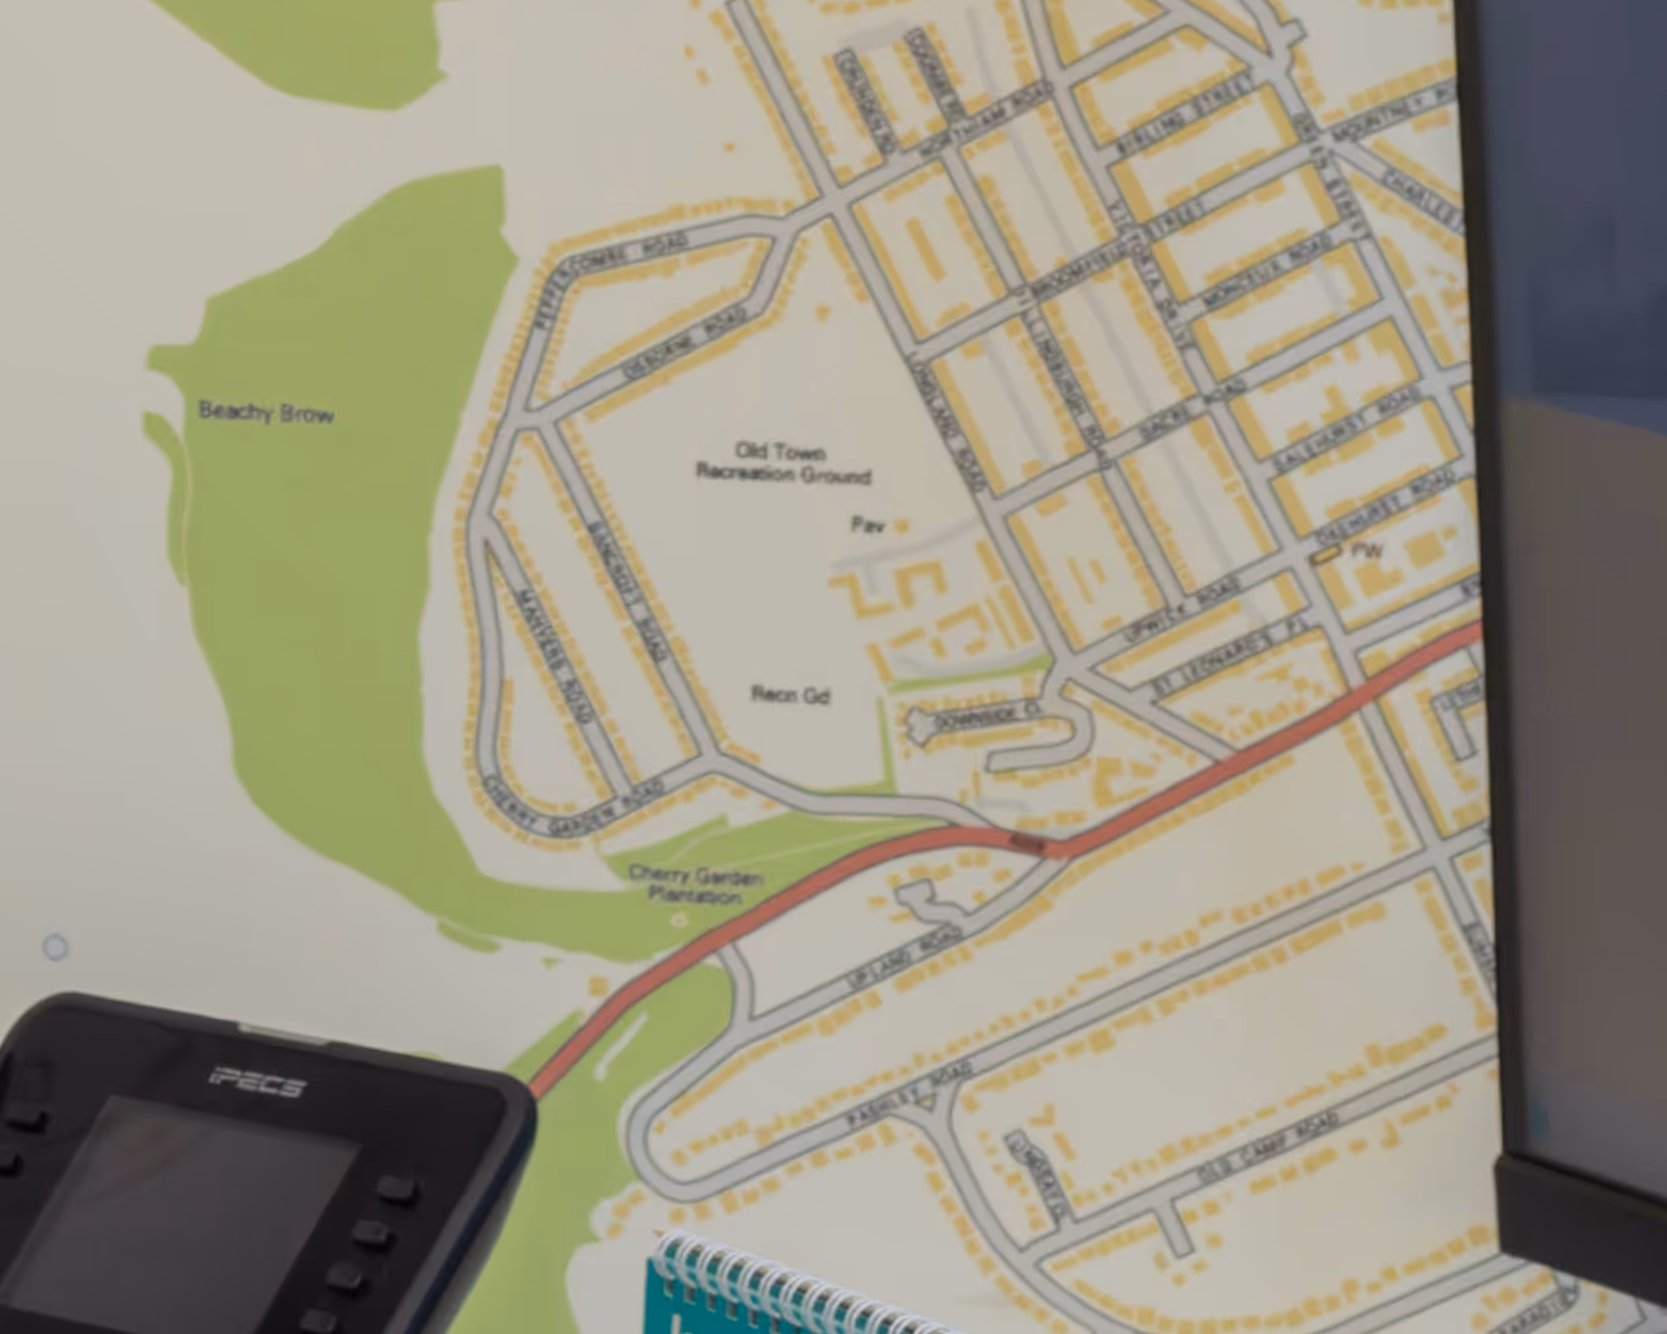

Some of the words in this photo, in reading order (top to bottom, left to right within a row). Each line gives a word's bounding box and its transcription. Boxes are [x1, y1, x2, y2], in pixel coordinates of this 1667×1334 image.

[198, 398, 273, 425] Beachy
[280, 403, 335, 425] Brow
[736, 442, 768, 460] Old
[774, 444, 827, 462] Town
[697, 462, 795, 483] Recreation
[801, 467, 873, 487] Ground
[852, 516, 886, 535] Pav
[1352, 543, 1383, 559] PW
[752, 685, 796, 705] Recn
[801, 687, 831, 706] Gd
[628, 865, 691, 889] Cherry
[697, 867, 765, 887] Garden
[649, 885, 743, 907] Plantation
